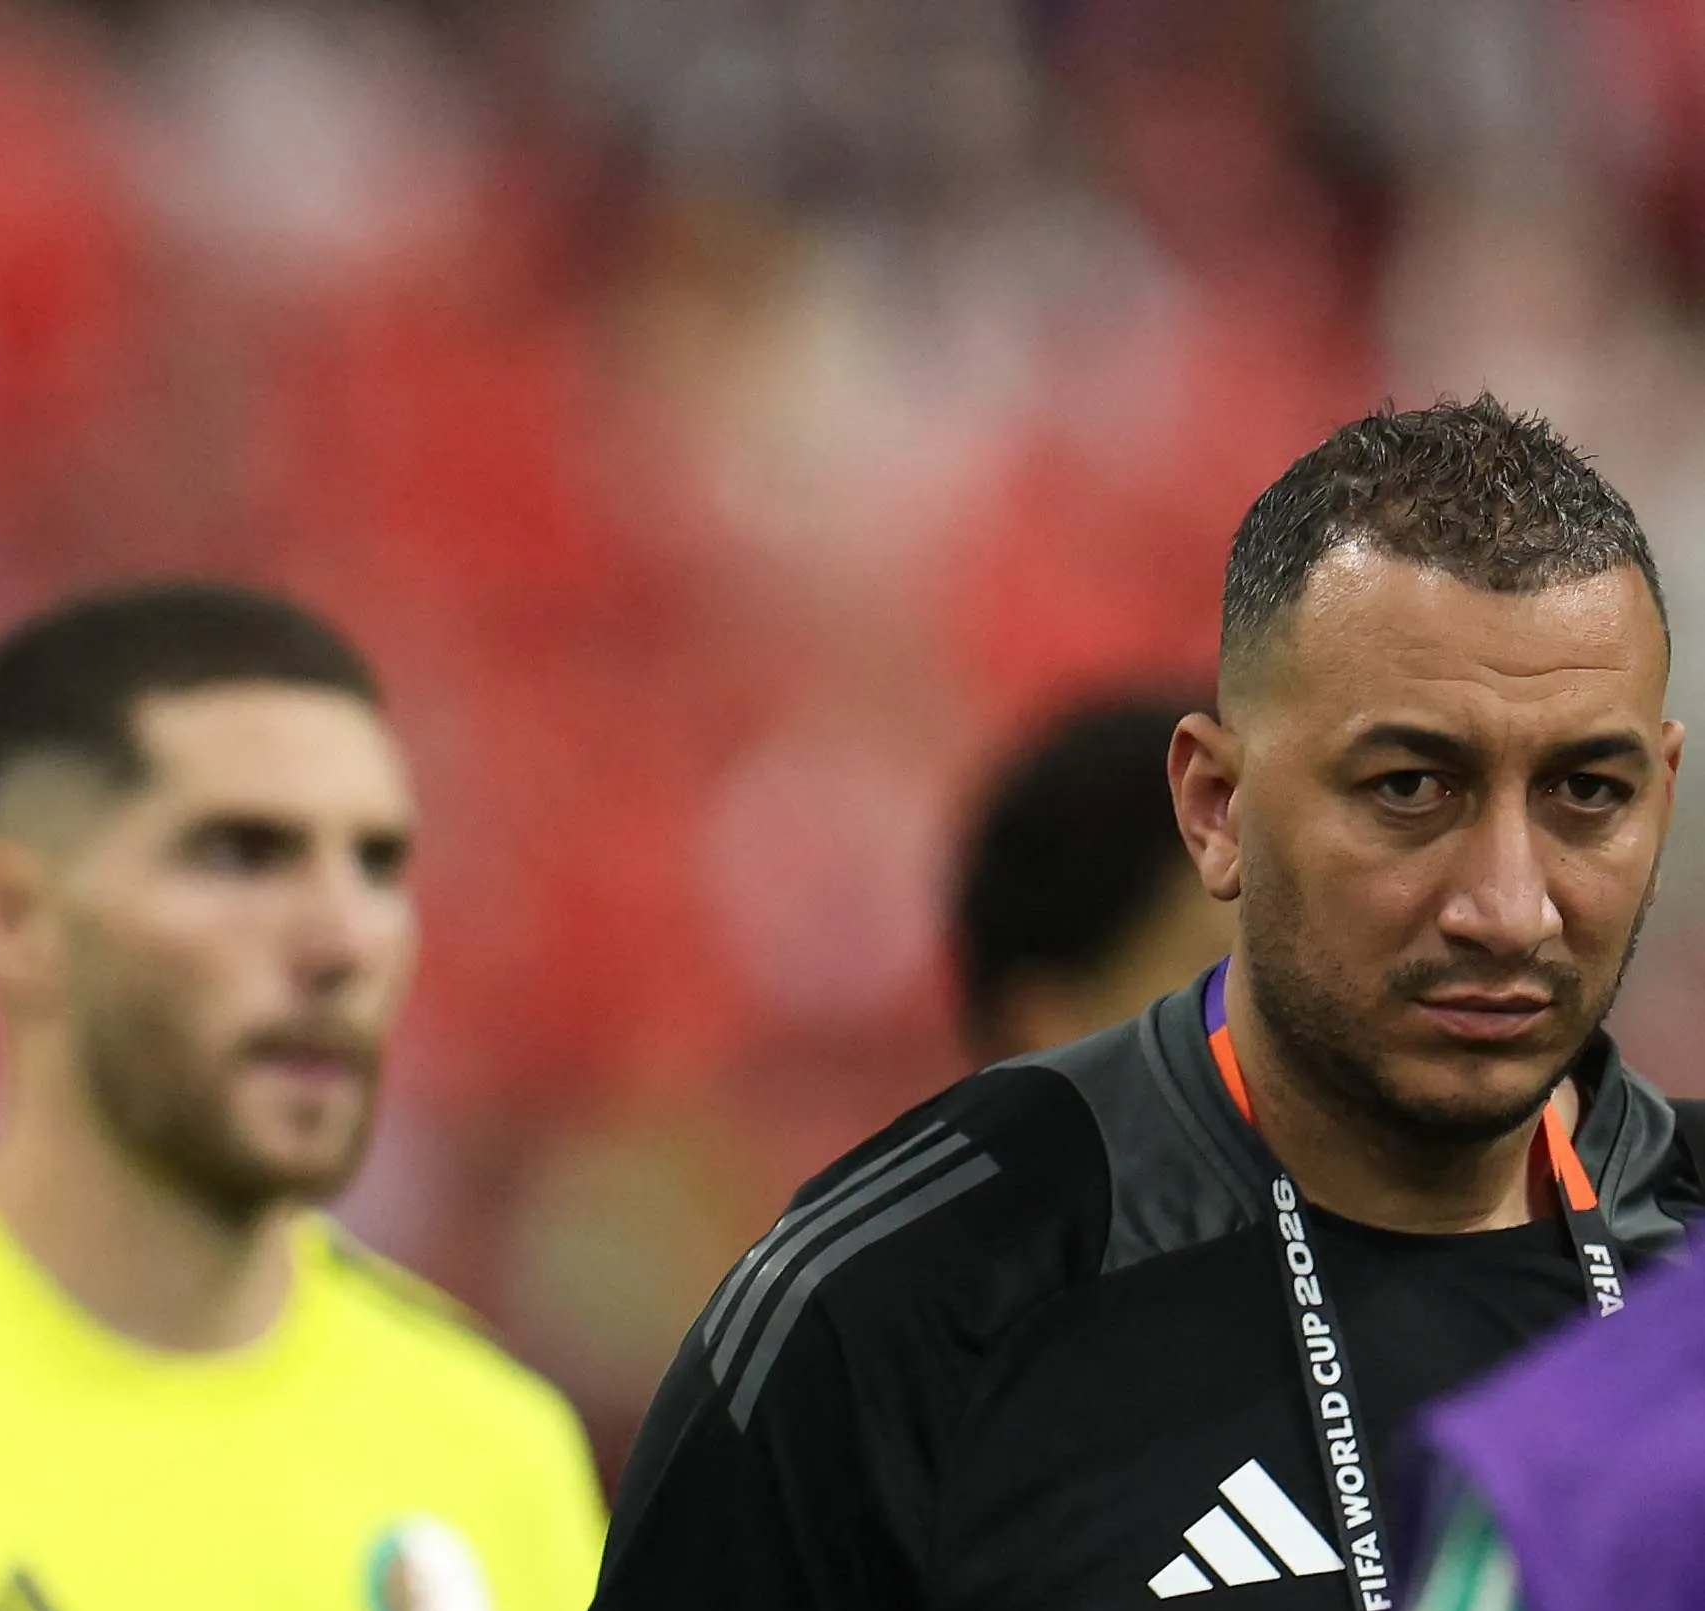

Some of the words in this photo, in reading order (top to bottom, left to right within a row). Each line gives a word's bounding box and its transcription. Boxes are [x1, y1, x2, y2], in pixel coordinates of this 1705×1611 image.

[1272, 1178, 1322, 1307] 2026
[1583, 1242, 1625, 1317] FIFA
[1300, 1313, 1341, 1384] CUP
[1320, 1392, 1372, 1530] WORLD
[1351, 1536, 1392, 1611] FIFA
